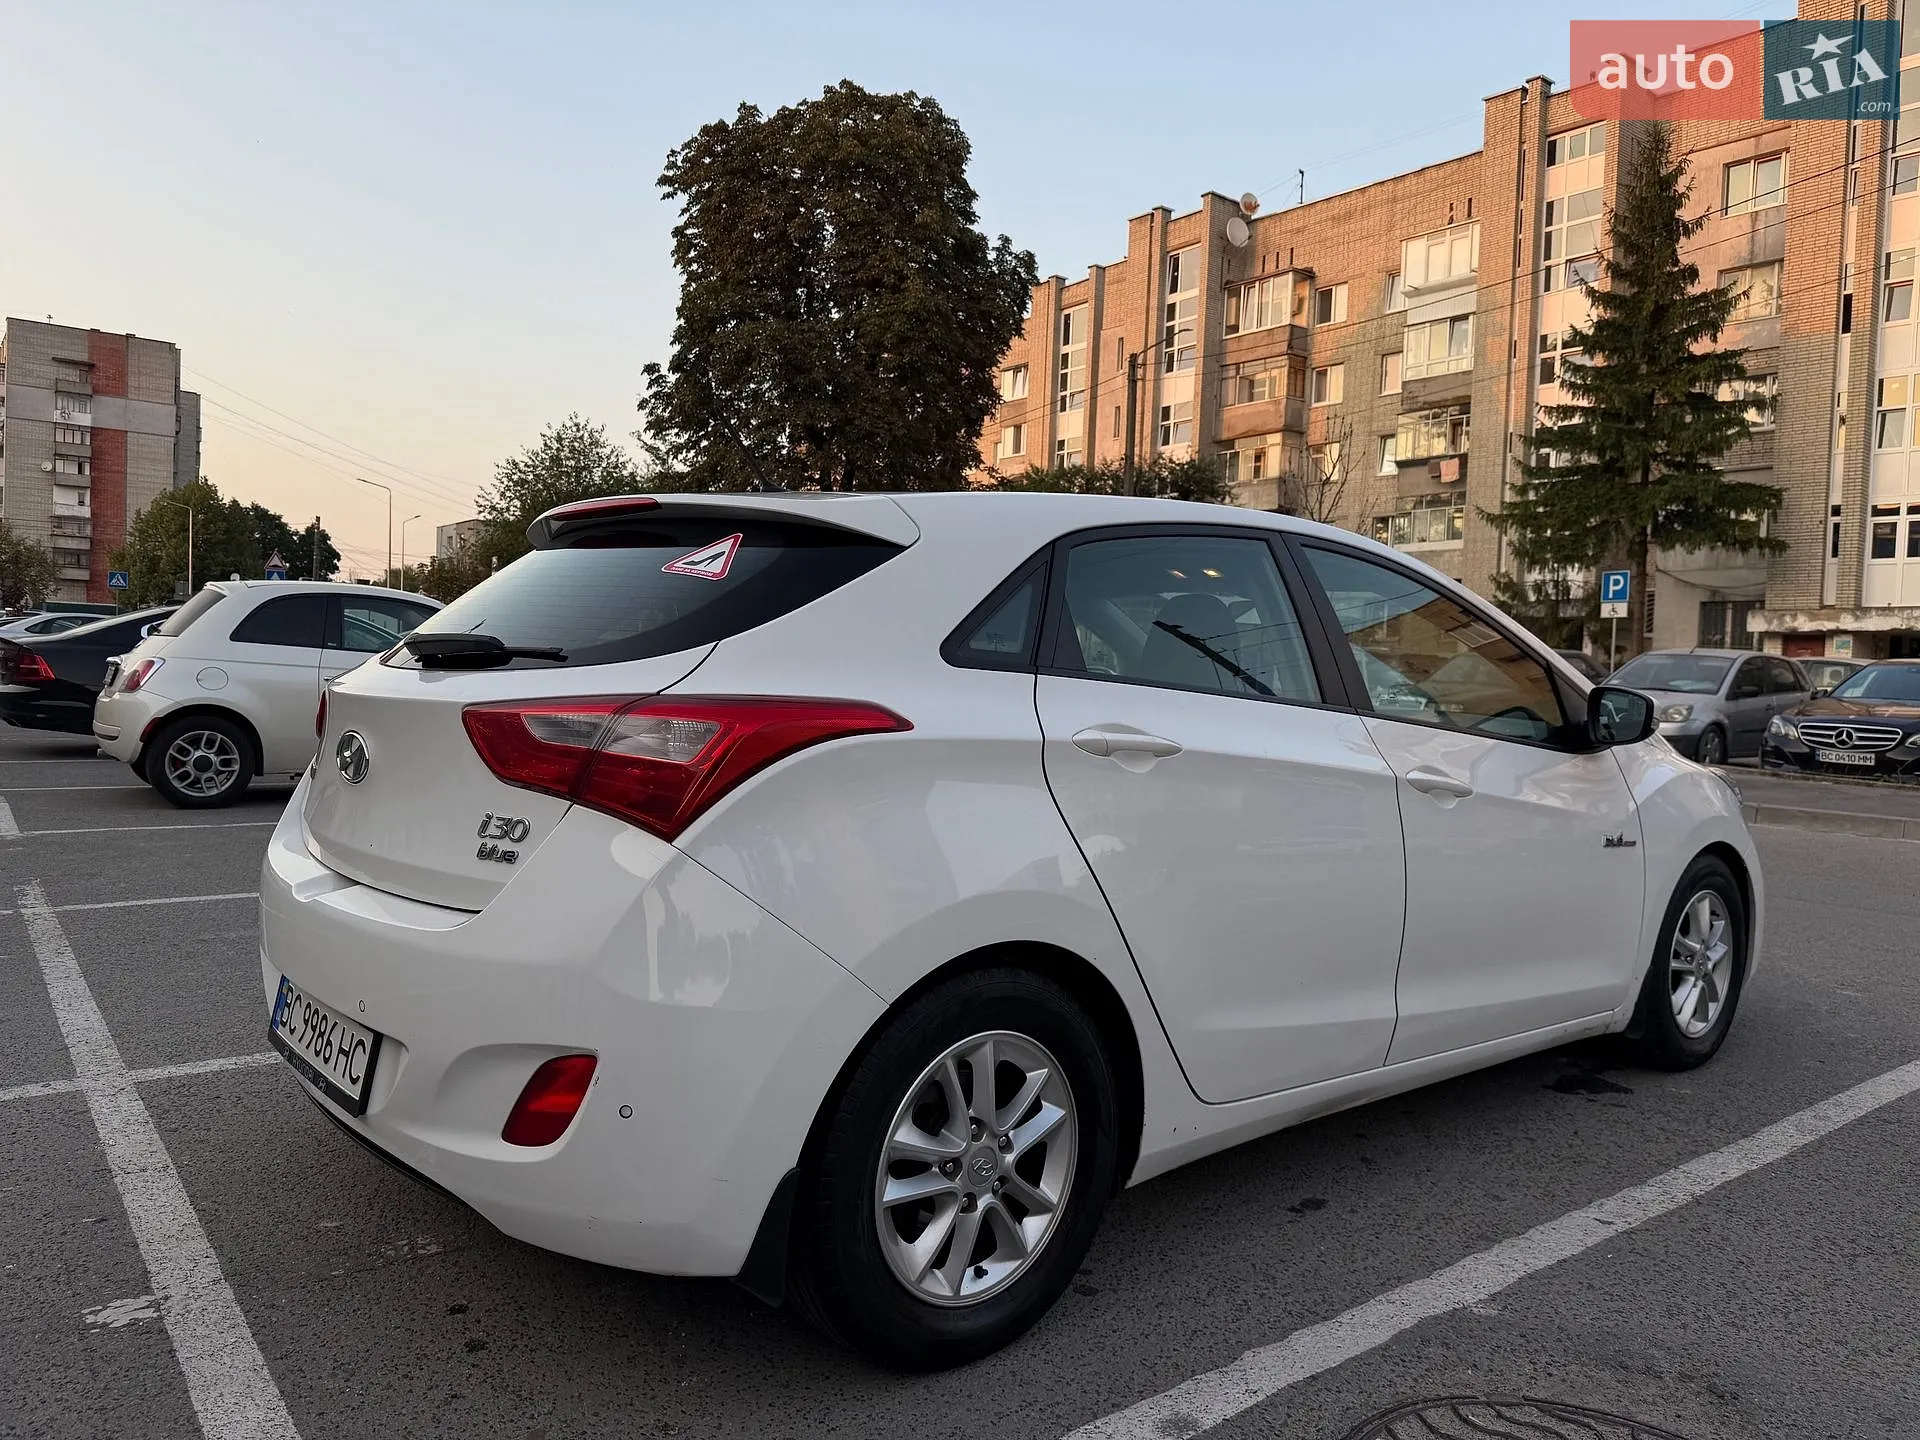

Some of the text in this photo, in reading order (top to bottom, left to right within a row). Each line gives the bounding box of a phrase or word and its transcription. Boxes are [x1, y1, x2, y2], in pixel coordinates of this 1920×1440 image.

[1608, 575, 1625, 599] P
[477, 811, 531, 843] i30
[476, 841, 519, 864] blue
[280, 984, 302, 1035] BC
[298, 1001, 338, 1064] 9986
[333, 1026, 366, 1085] HC
